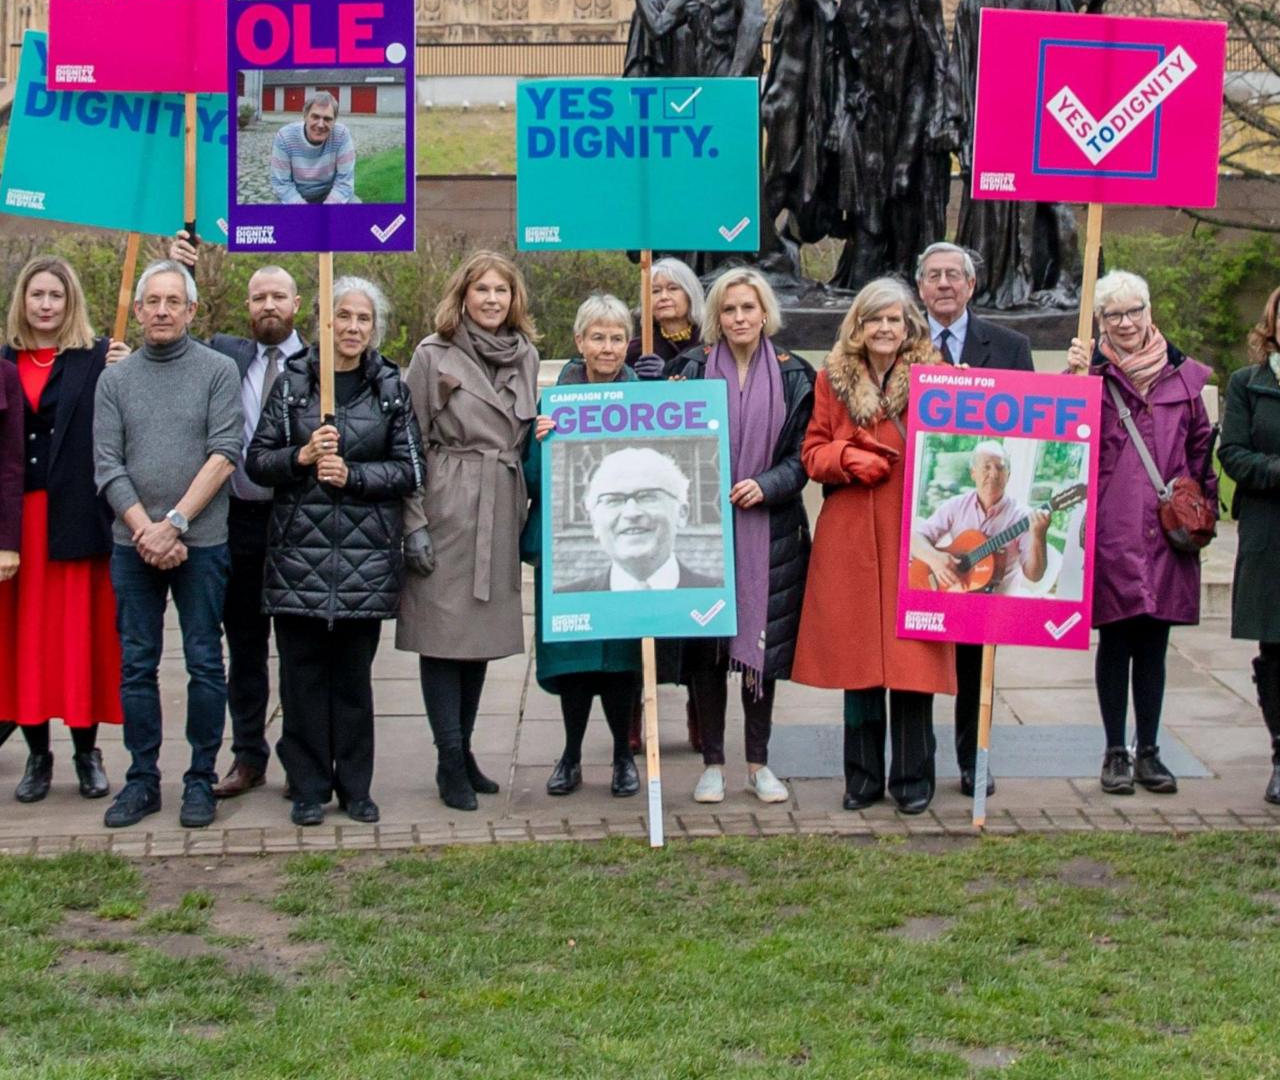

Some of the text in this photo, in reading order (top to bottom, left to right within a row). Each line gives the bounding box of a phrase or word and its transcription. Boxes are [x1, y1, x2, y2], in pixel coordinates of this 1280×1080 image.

[236, 3, 406, 66] OLE.
[525, 87, 613, 120] YES
[1057, 53, 1186, 153] YES TO DIGNITY
[527, 125, 719, 159] DIGNITY.
[550, 391, 624, 403] CAMPAIGN FOR
[919, 374, 995, 388] CAMPAIGN FOR
[918, 388, 1091, 439] GEOFF.
